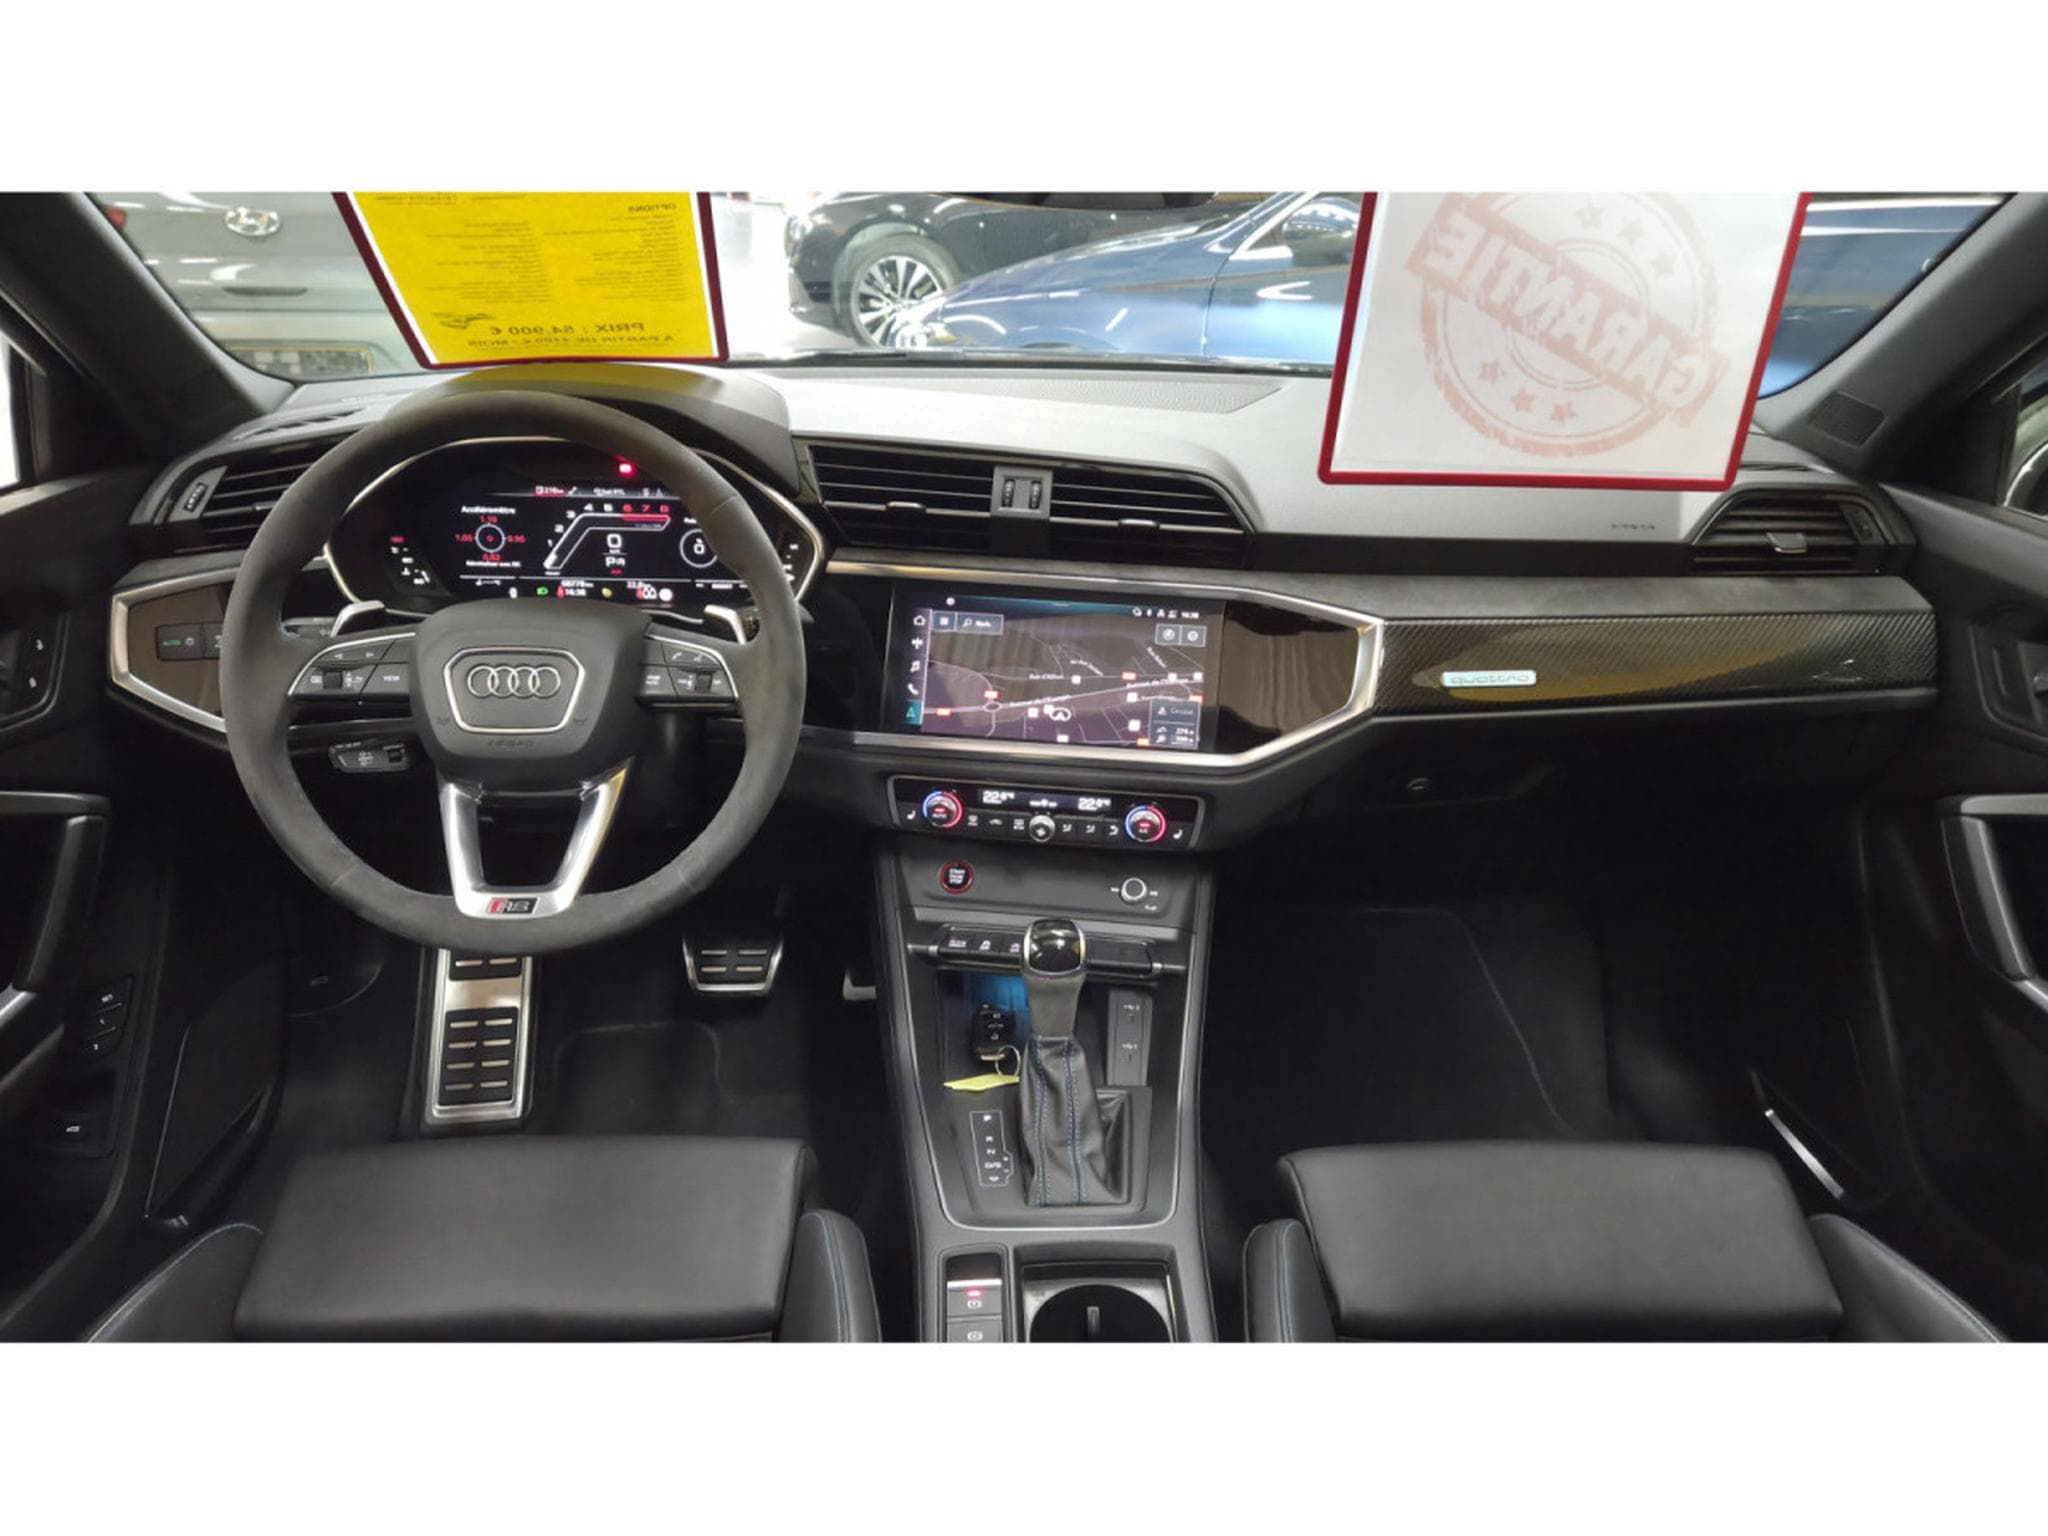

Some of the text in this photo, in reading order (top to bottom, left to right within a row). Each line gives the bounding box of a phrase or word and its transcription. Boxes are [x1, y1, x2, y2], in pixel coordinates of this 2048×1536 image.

[583, 503, 594, 512] 4
[603, 503, 614, 513] 5
[641, 504, 653, 513] 7
[565, 509, 577, 520] 3
[554, 523, 565, 534] 2
[606, 532, 624, 549] 0
